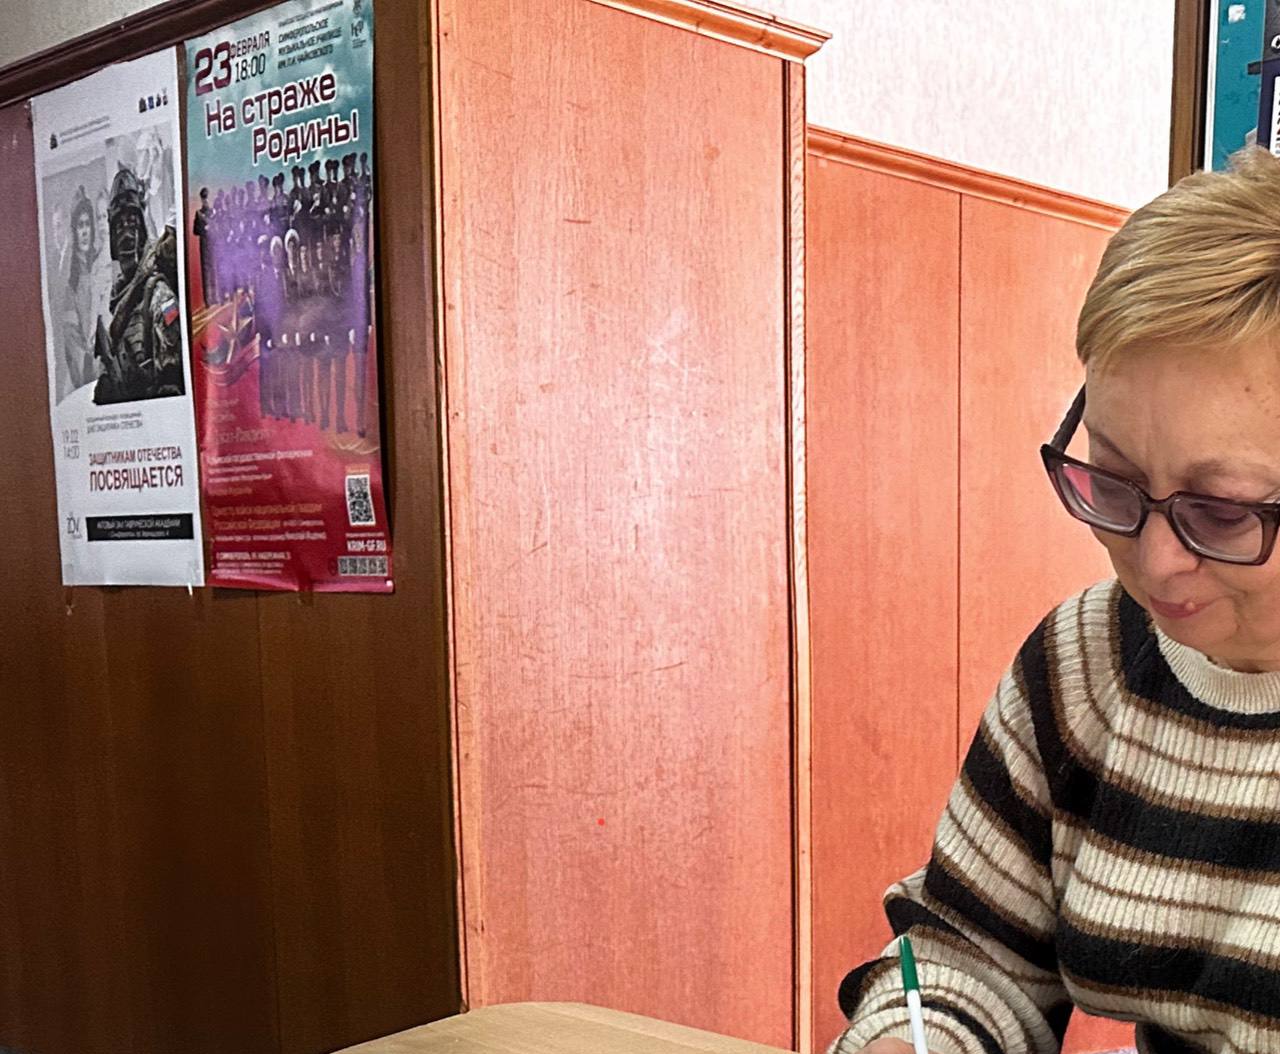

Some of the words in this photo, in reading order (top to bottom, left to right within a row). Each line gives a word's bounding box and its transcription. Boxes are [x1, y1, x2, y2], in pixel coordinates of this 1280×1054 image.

[230, 31, 271, 58] ФЕВРАЛЯ
[195, 40, 232, 96] 23
[235, 53, 266, 83] 18:00
[206, 99, 236, 137] На
[242, 73, 336, 126] страже
[253, 111, 358, 164] Родины
[89, 449, 136, 466] ЗАЩИТНИКАМ
[137, 446, 182, 463] ОТЕЧЕСТВА
[90, 465, 184, 493] ПОСВЯЩАЕТСЯ
